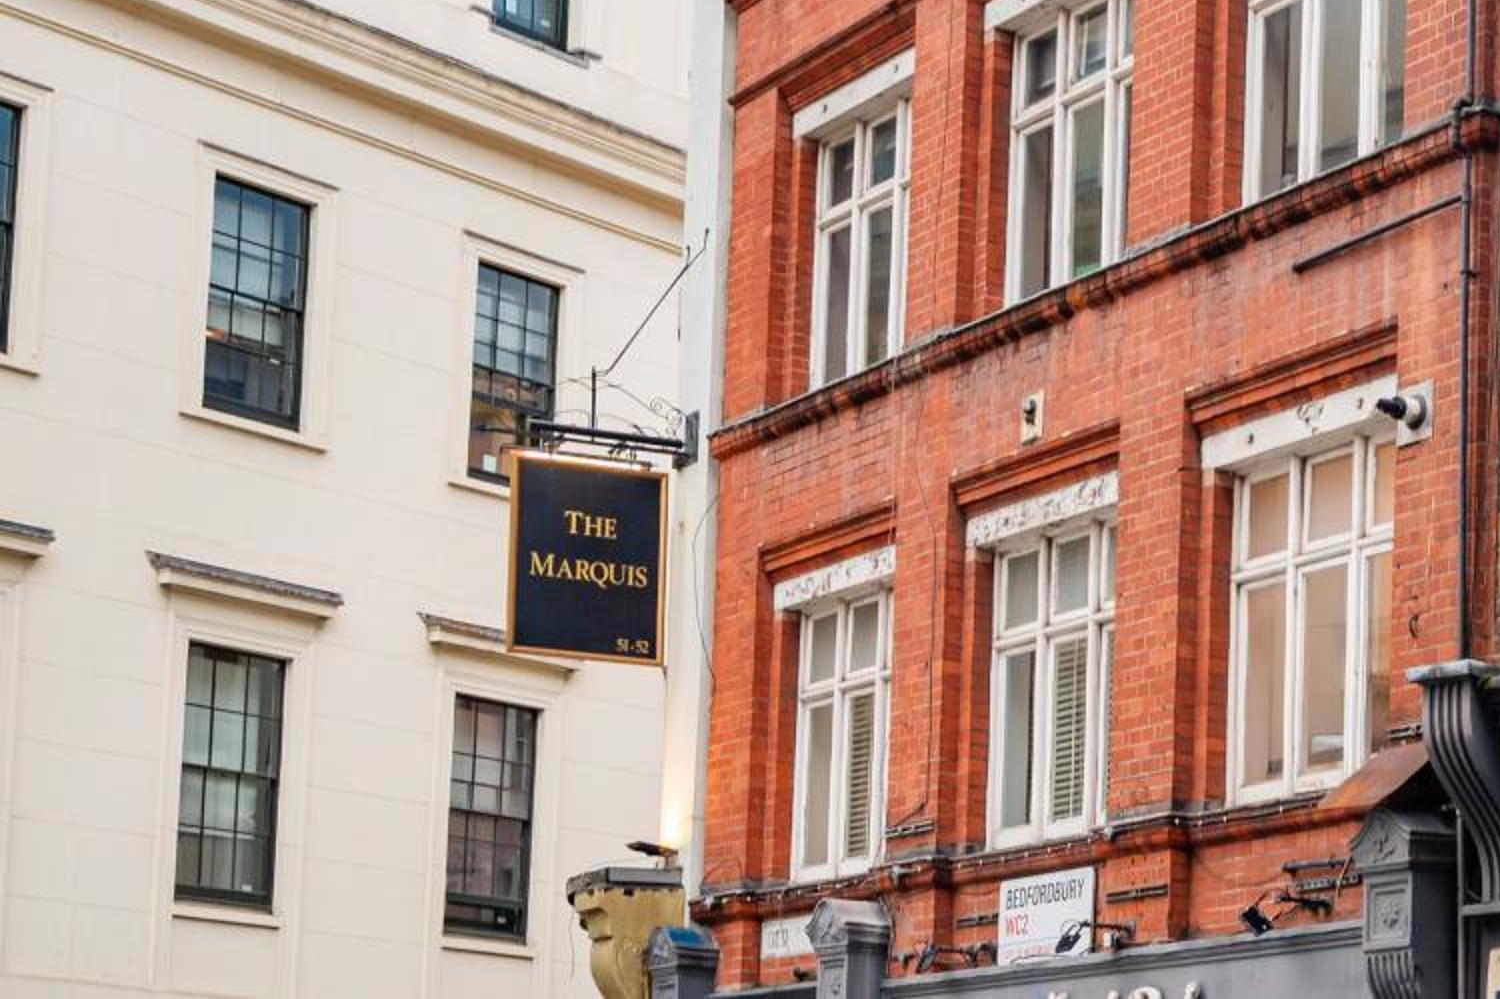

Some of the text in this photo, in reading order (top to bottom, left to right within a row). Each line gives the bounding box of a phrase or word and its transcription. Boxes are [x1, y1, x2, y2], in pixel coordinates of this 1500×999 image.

[564, 511, 617, 539] THE
[530, 552, 648, 589] MARQUIS
[1005, 877, 1085, 910] BEDFORDBURY
[1006, 913, 1030, 936] WC2
